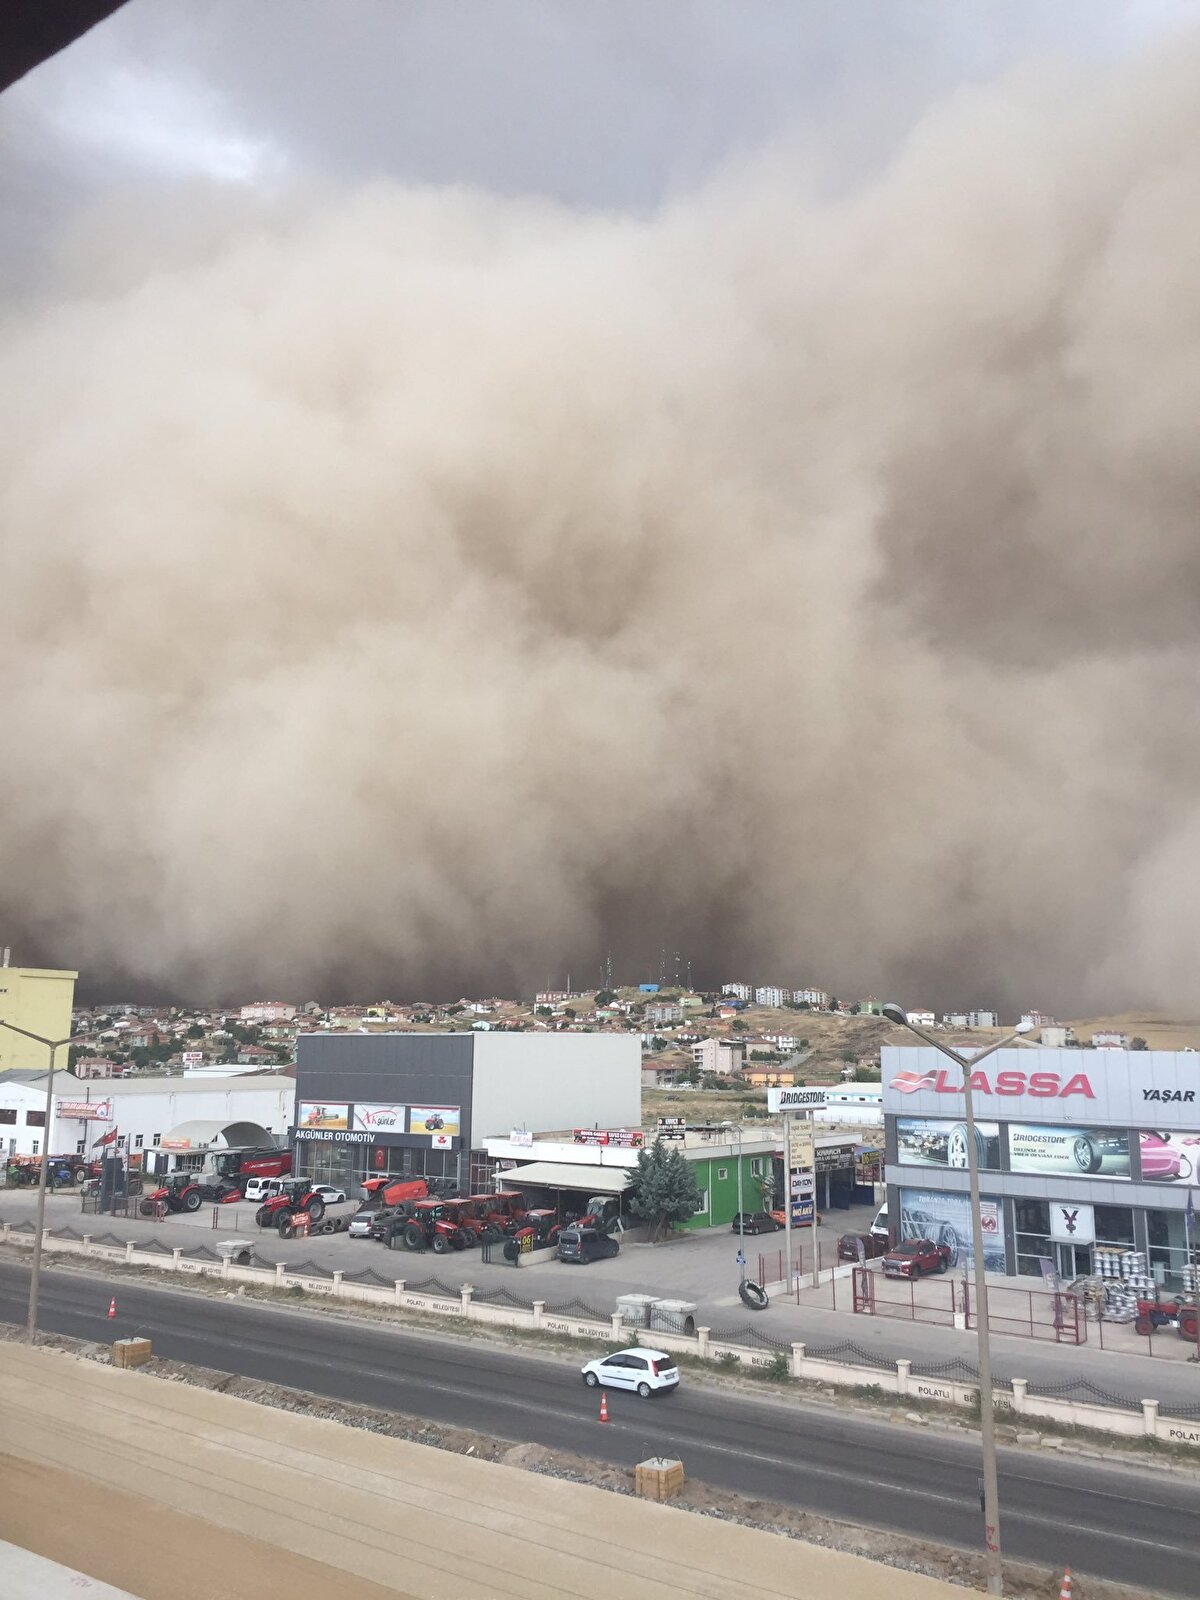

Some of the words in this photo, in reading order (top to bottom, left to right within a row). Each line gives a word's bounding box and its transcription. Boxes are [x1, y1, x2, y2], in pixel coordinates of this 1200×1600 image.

[935, 1070, 1096, 1099] LASSA
[780, 1091, 826, 1104] BRIDGESTONE
[1142, 1089, 1195, 1103] YAŞAR
[295, 1130, 334, 1141] AKGÜNLER
[335, 1131, 376, 1143] OTOMOTİV
[1013, 1133, 1067, 1144] BRIDGESTONE
[406, 1298, 426, 1307] POLATLI
[547, 1321, 569, 1331] POLATLI
[918, 1386, 949, 1398] POLATLI
